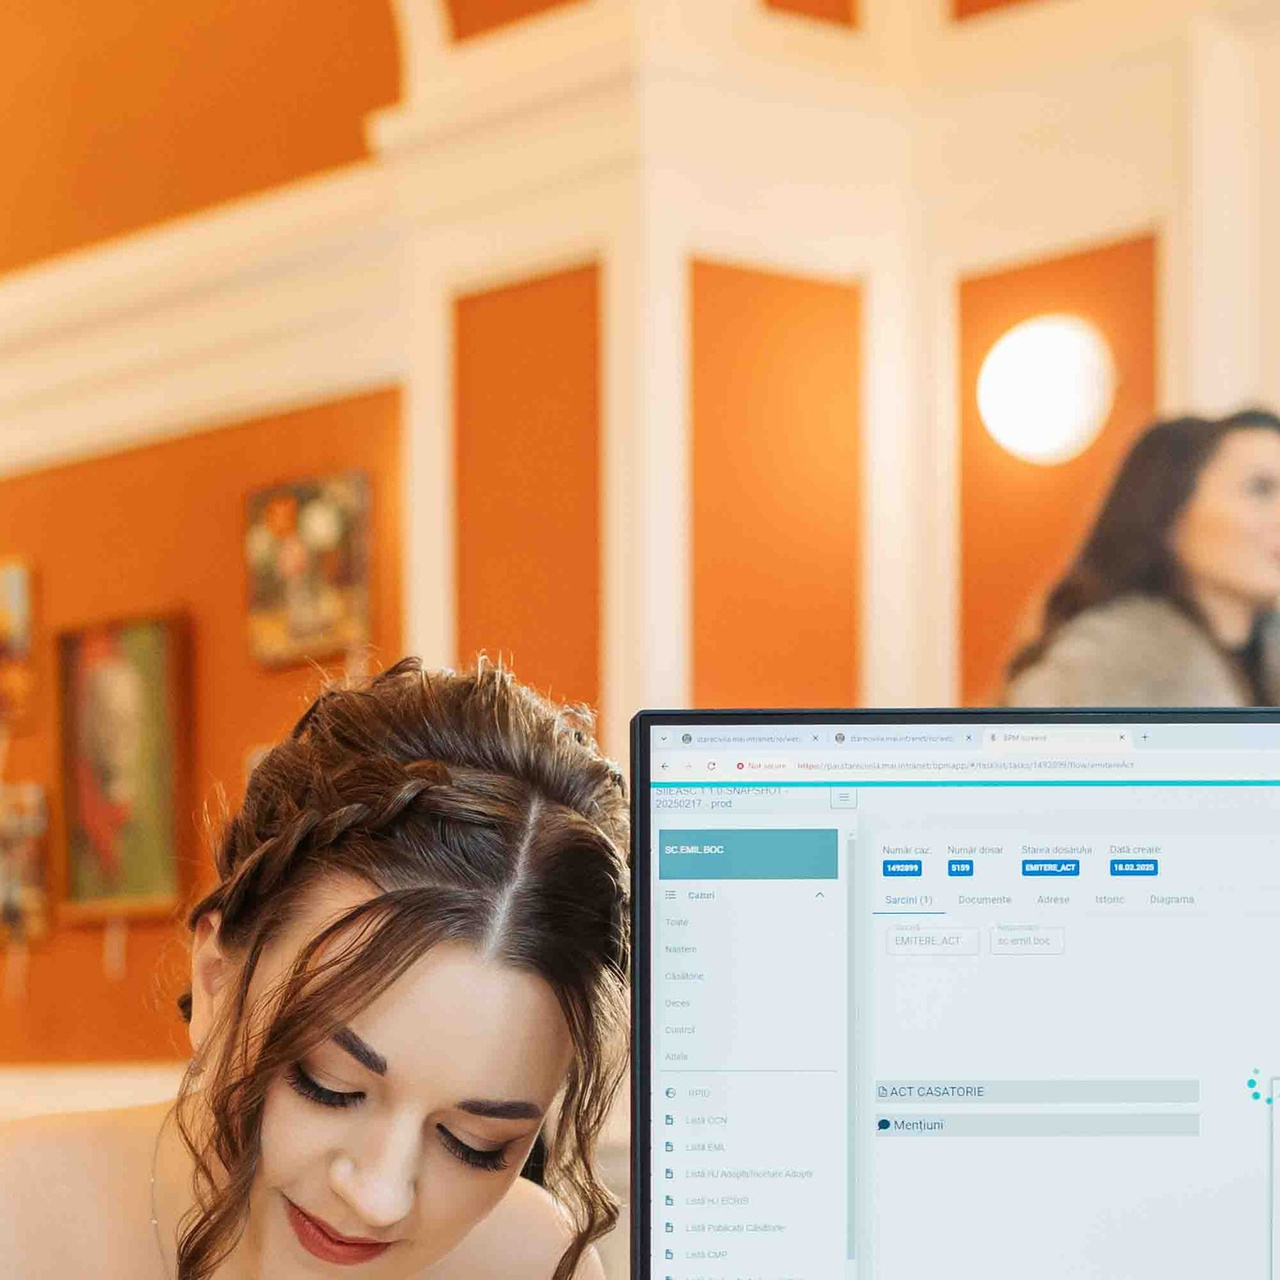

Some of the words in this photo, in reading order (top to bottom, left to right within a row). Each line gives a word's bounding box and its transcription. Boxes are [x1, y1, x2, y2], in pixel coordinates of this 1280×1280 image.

[655, 798, 702, 809] 20250217
[710, 799, 732, 810] prod
[885, 863, 919, 873] 1492899
[950, 863, 971, 873] 5159
[1113, 863, 1155, 872] 18.02.2025
[885, 895, 918, 905] Sarcini
[919, 895, 934, 906] (1)
[957, 895, 1013, 905] Documente
[1037, 895, 1071, 905] Adrese
[1095, 895, 1125, 905] Istoric
[1149, 894, 1195, 906] Diagrama
[664, 918, 689, 927] Toate
[890, 1085, 915, 1097] ACT
[917, 1085, 985, 1097] CASATORIE
